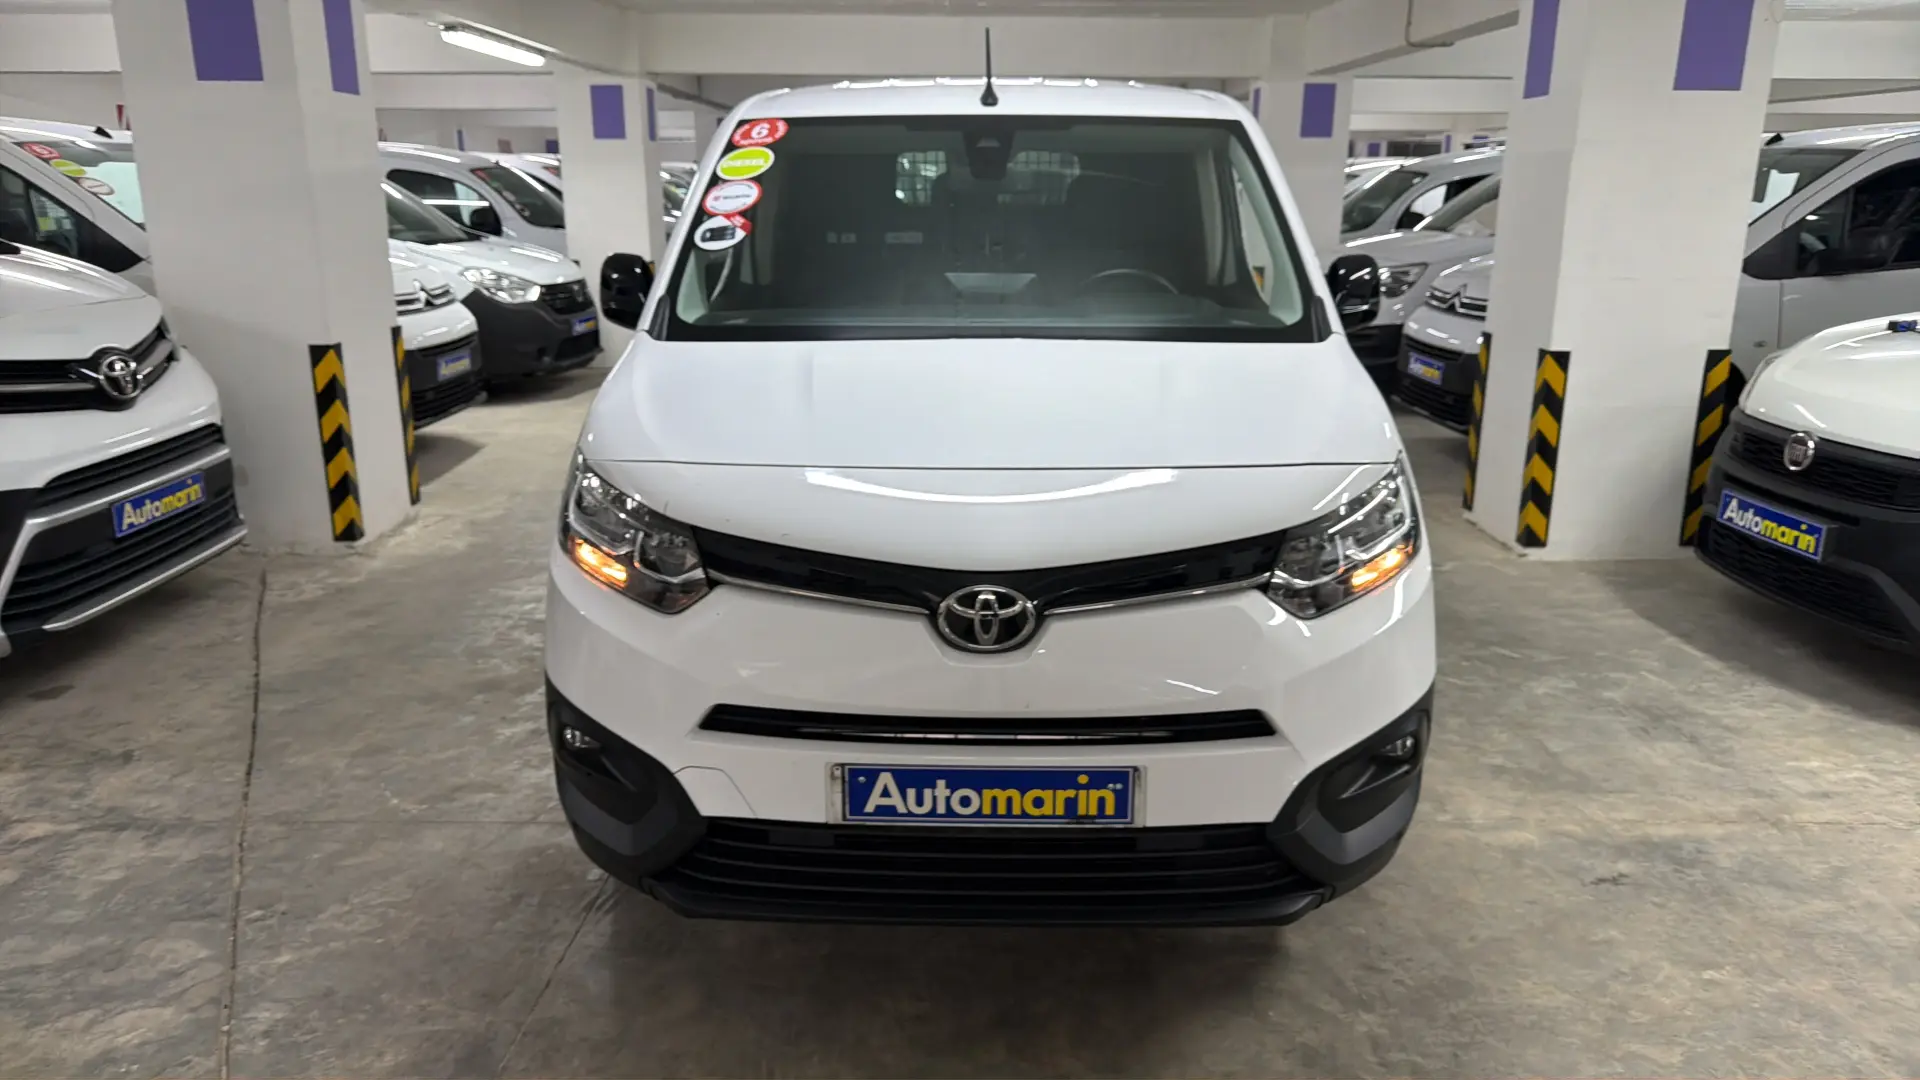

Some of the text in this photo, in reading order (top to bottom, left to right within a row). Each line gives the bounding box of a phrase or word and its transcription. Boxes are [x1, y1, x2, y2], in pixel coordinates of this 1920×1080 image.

[751, 123, 770, 139] 6
[122, 478, 202, 530] Automarin
[1722, 498, 1816, 553] Automarin
[863, 771, 1116, 815] Automarin
